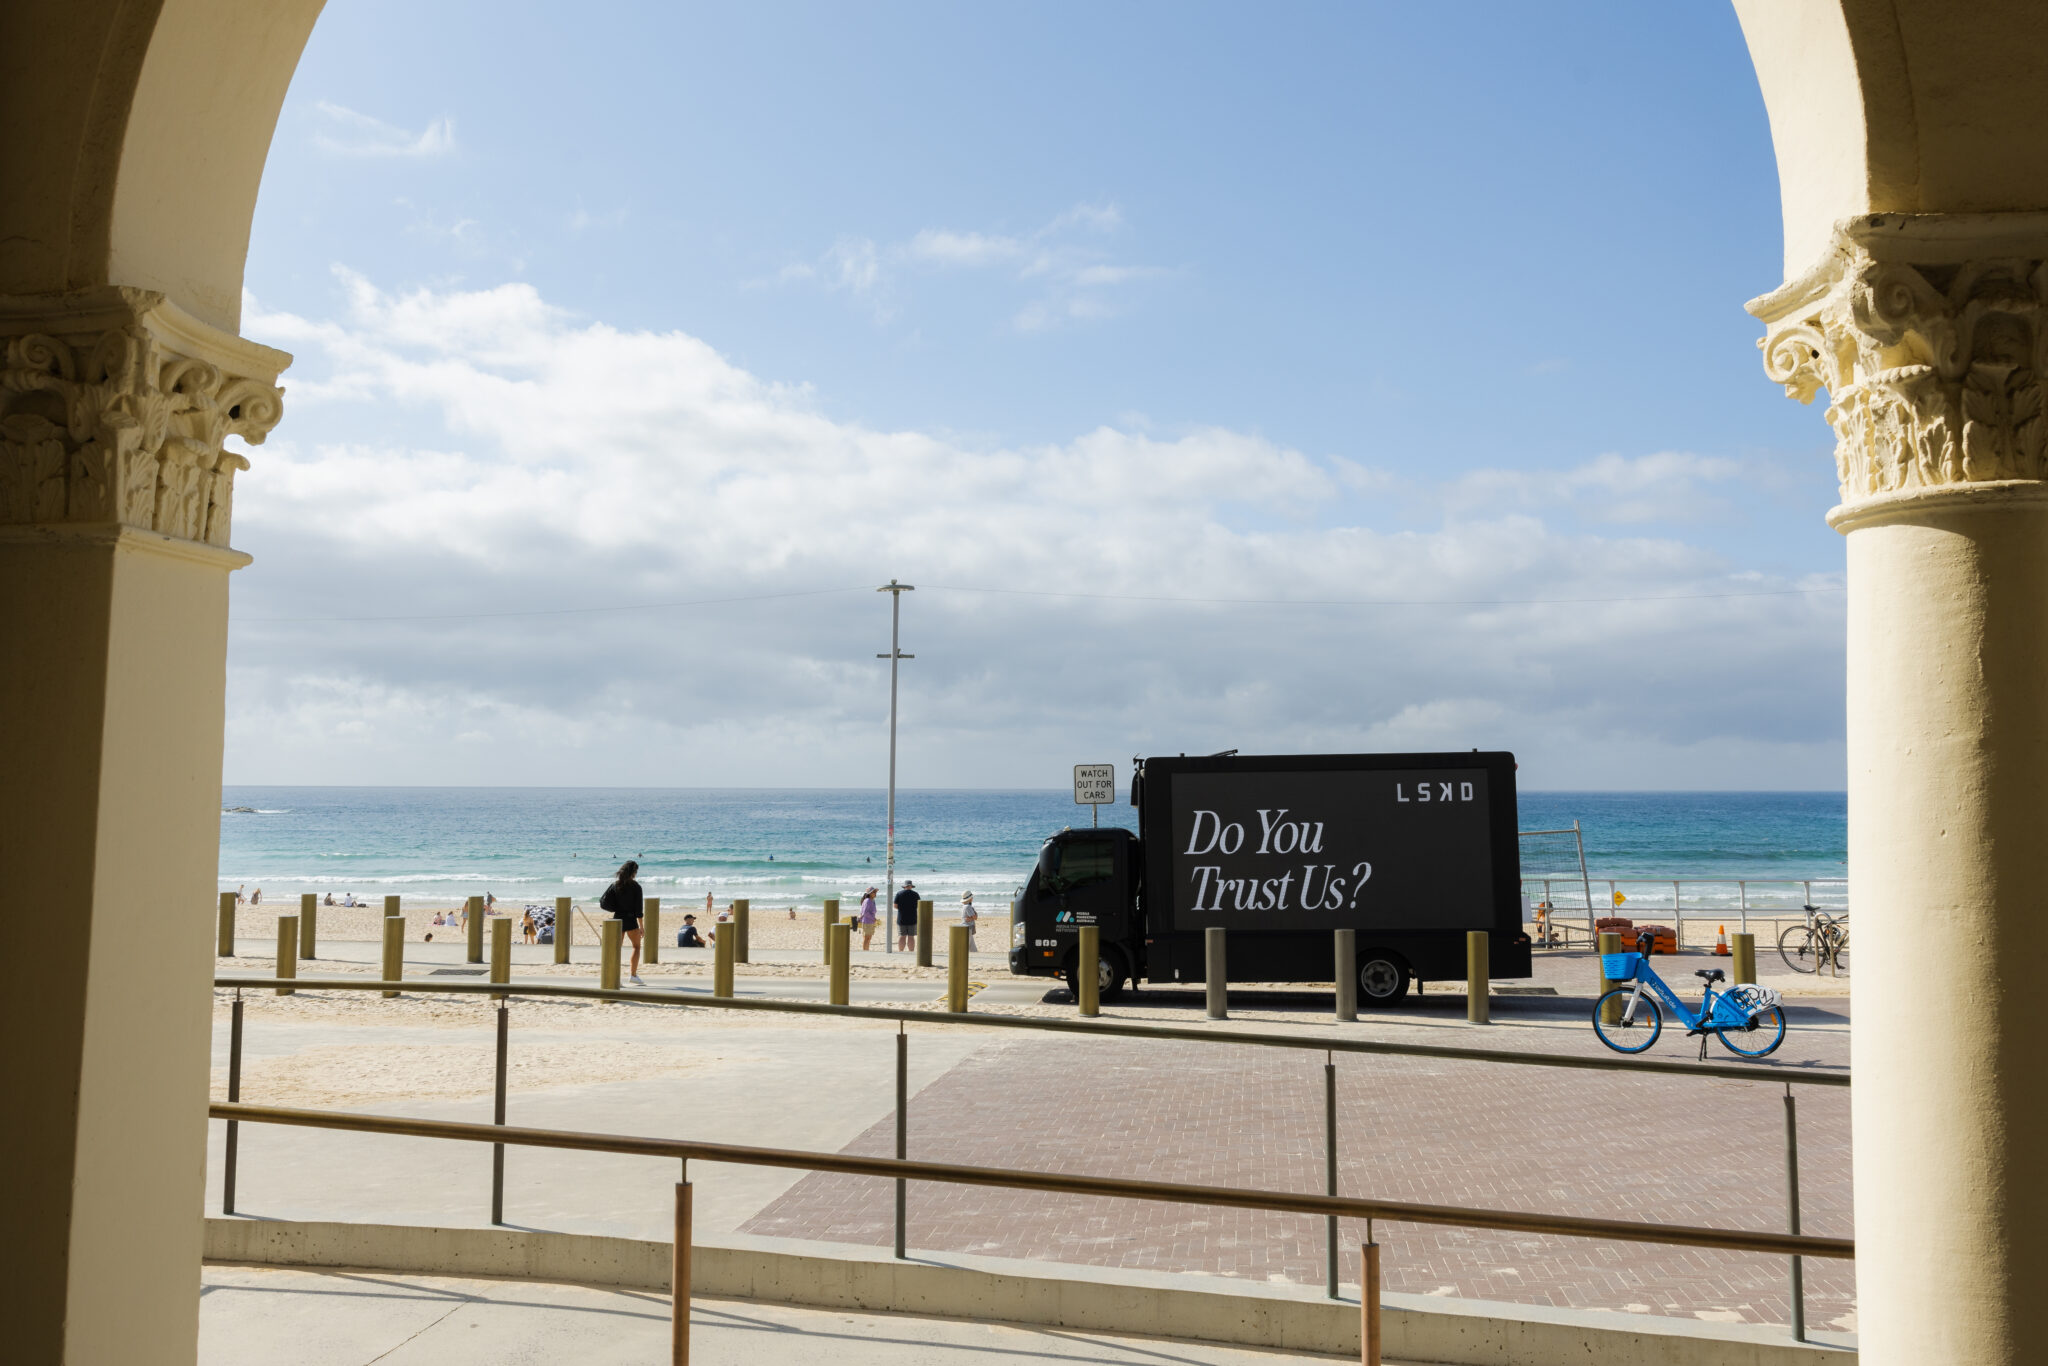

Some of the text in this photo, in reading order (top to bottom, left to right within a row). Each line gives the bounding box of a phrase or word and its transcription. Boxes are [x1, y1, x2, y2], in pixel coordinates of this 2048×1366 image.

[1081, 769, 1108, 778] WATCH
[1077, 780, 1112, 789] OUT FOR
[1084, 791, 1106, 799] CARS
[1397, 782, 1474, 802] LSKD
[1184, 809, 1324, 855] Do You
[1190, 861, 1372, 911] Trust Us?
